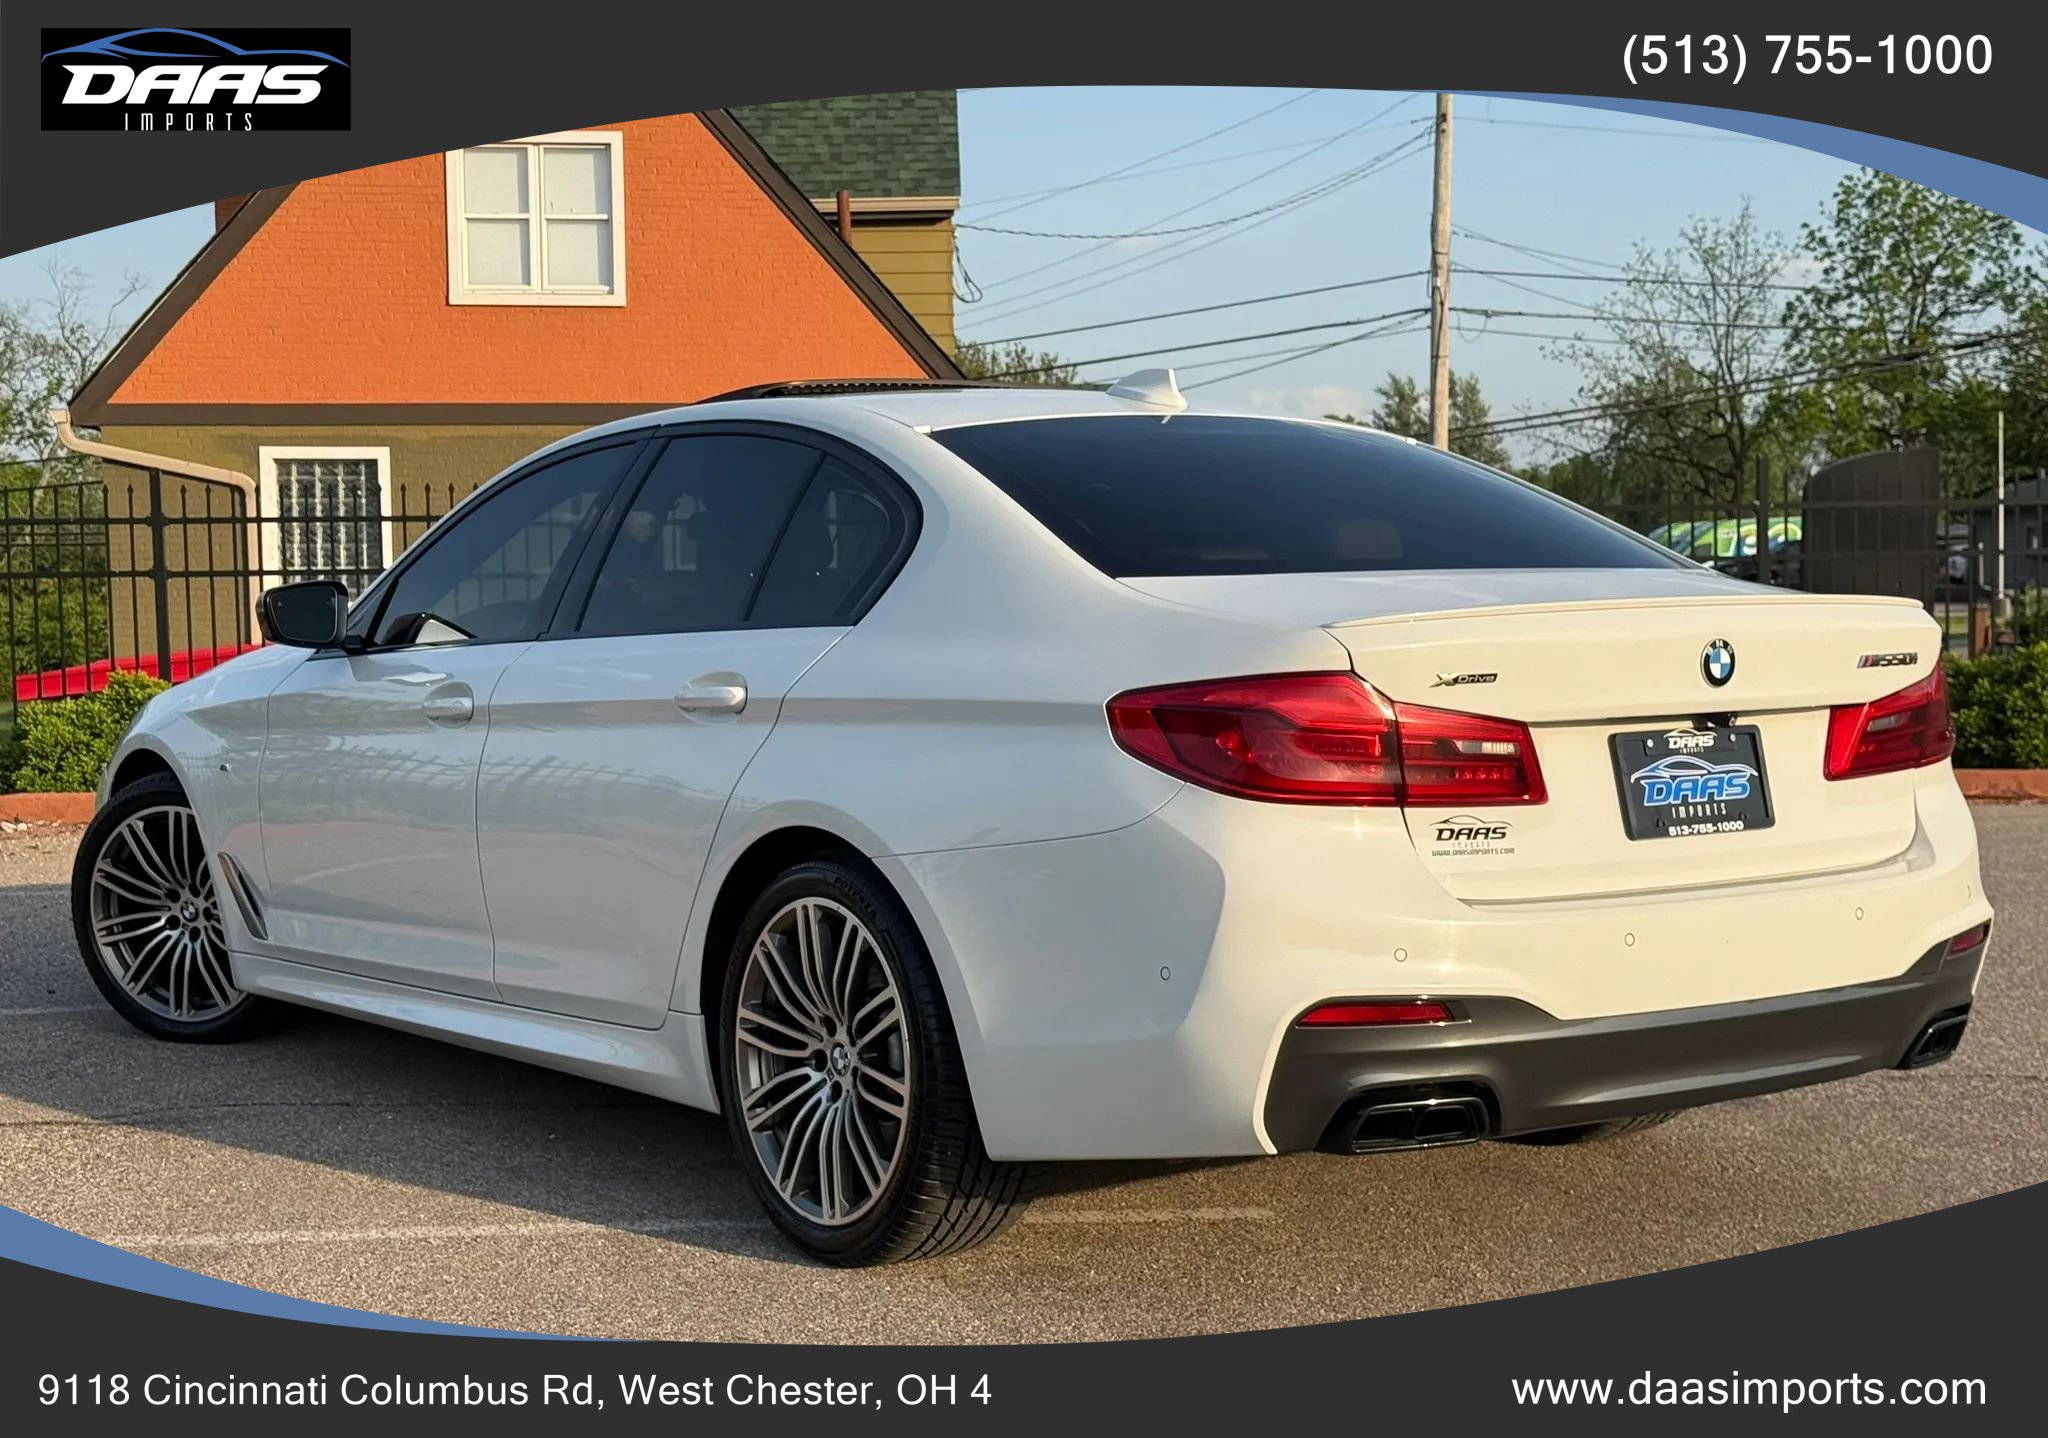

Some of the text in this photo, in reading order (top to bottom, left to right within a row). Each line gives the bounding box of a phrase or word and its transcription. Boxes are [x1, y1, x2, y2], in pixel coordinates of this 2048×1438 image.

[1669, 735, 1715, 749] DAAS
[1640, 772, 1751, 806] DAAS
[1672, 803, 1727, 819] IMPORTS
[1436, 826, 1508, 841] DAAS
[1668, 820, 1744, 836] 513-755-1000
